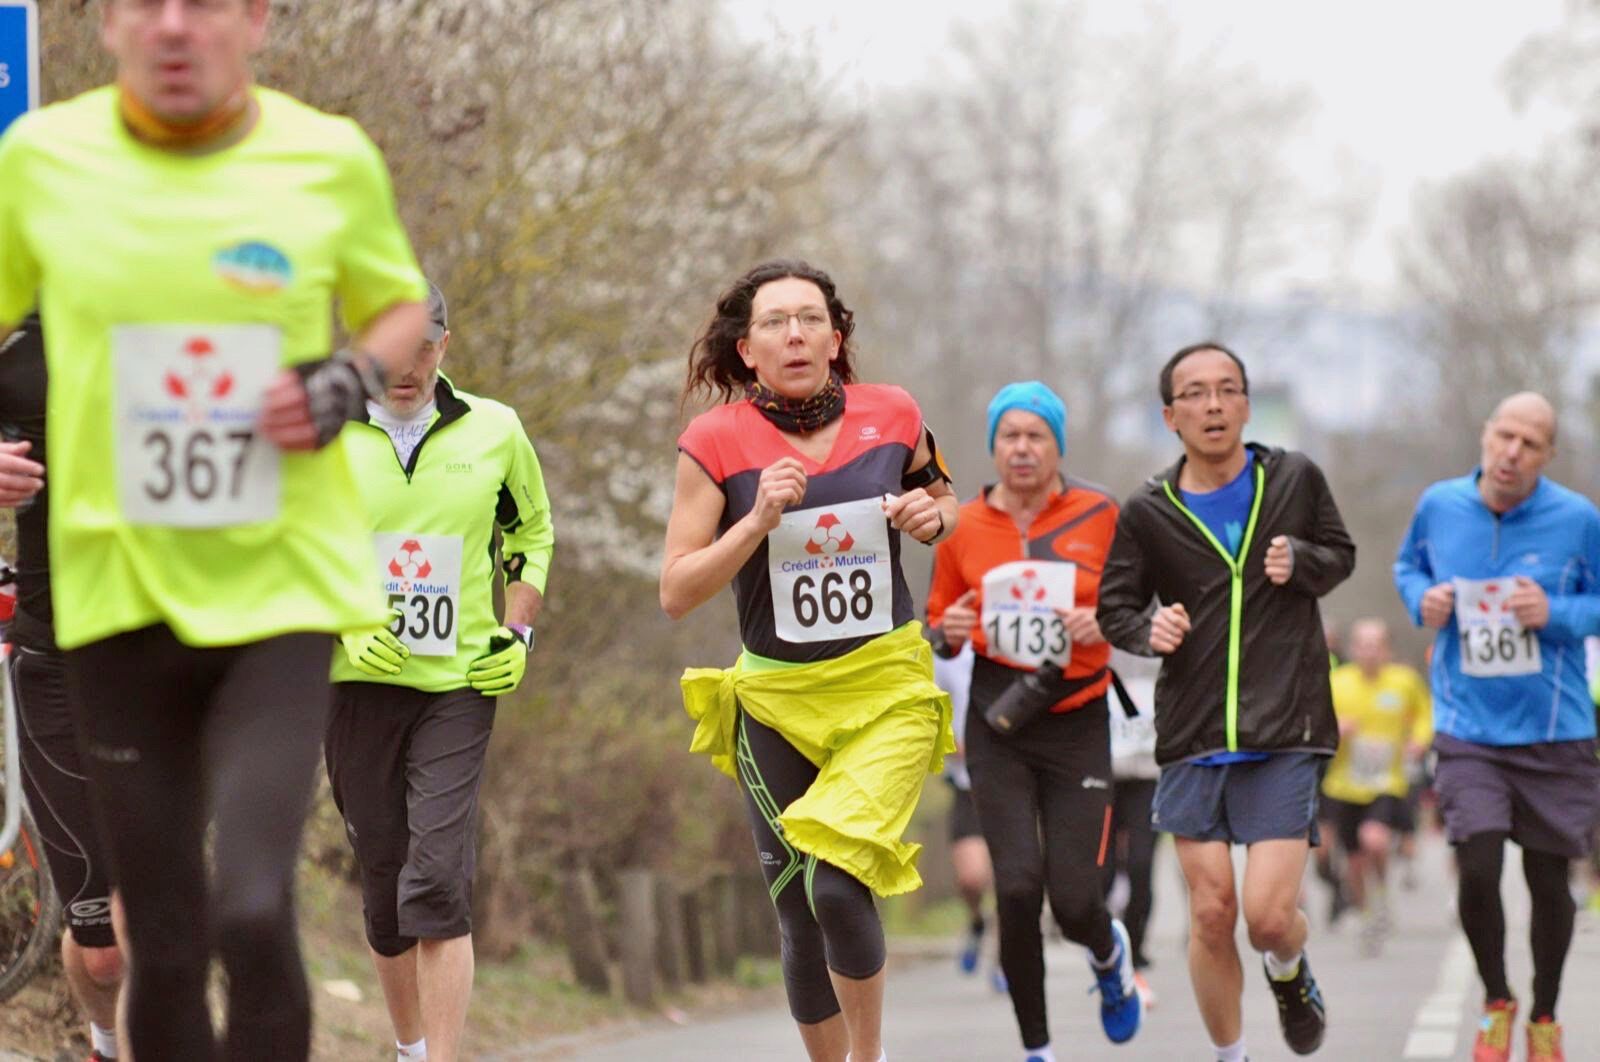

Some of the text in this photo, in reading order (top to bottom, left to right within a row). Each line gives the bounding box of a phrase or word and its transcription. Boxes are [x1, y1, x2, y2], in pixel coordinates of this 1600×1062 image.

[143, 430, 253, 502] 367
[782, 553, 877, 572] Crédit Mutuel
[385, 581, 449, 594] dit Mutuel
[792, 568, 873, 628] 668
[388, 594, 454, 641] 530
[987, 614, 1067, 655] 1133
[1461, 626, 1534, 665] 1361
